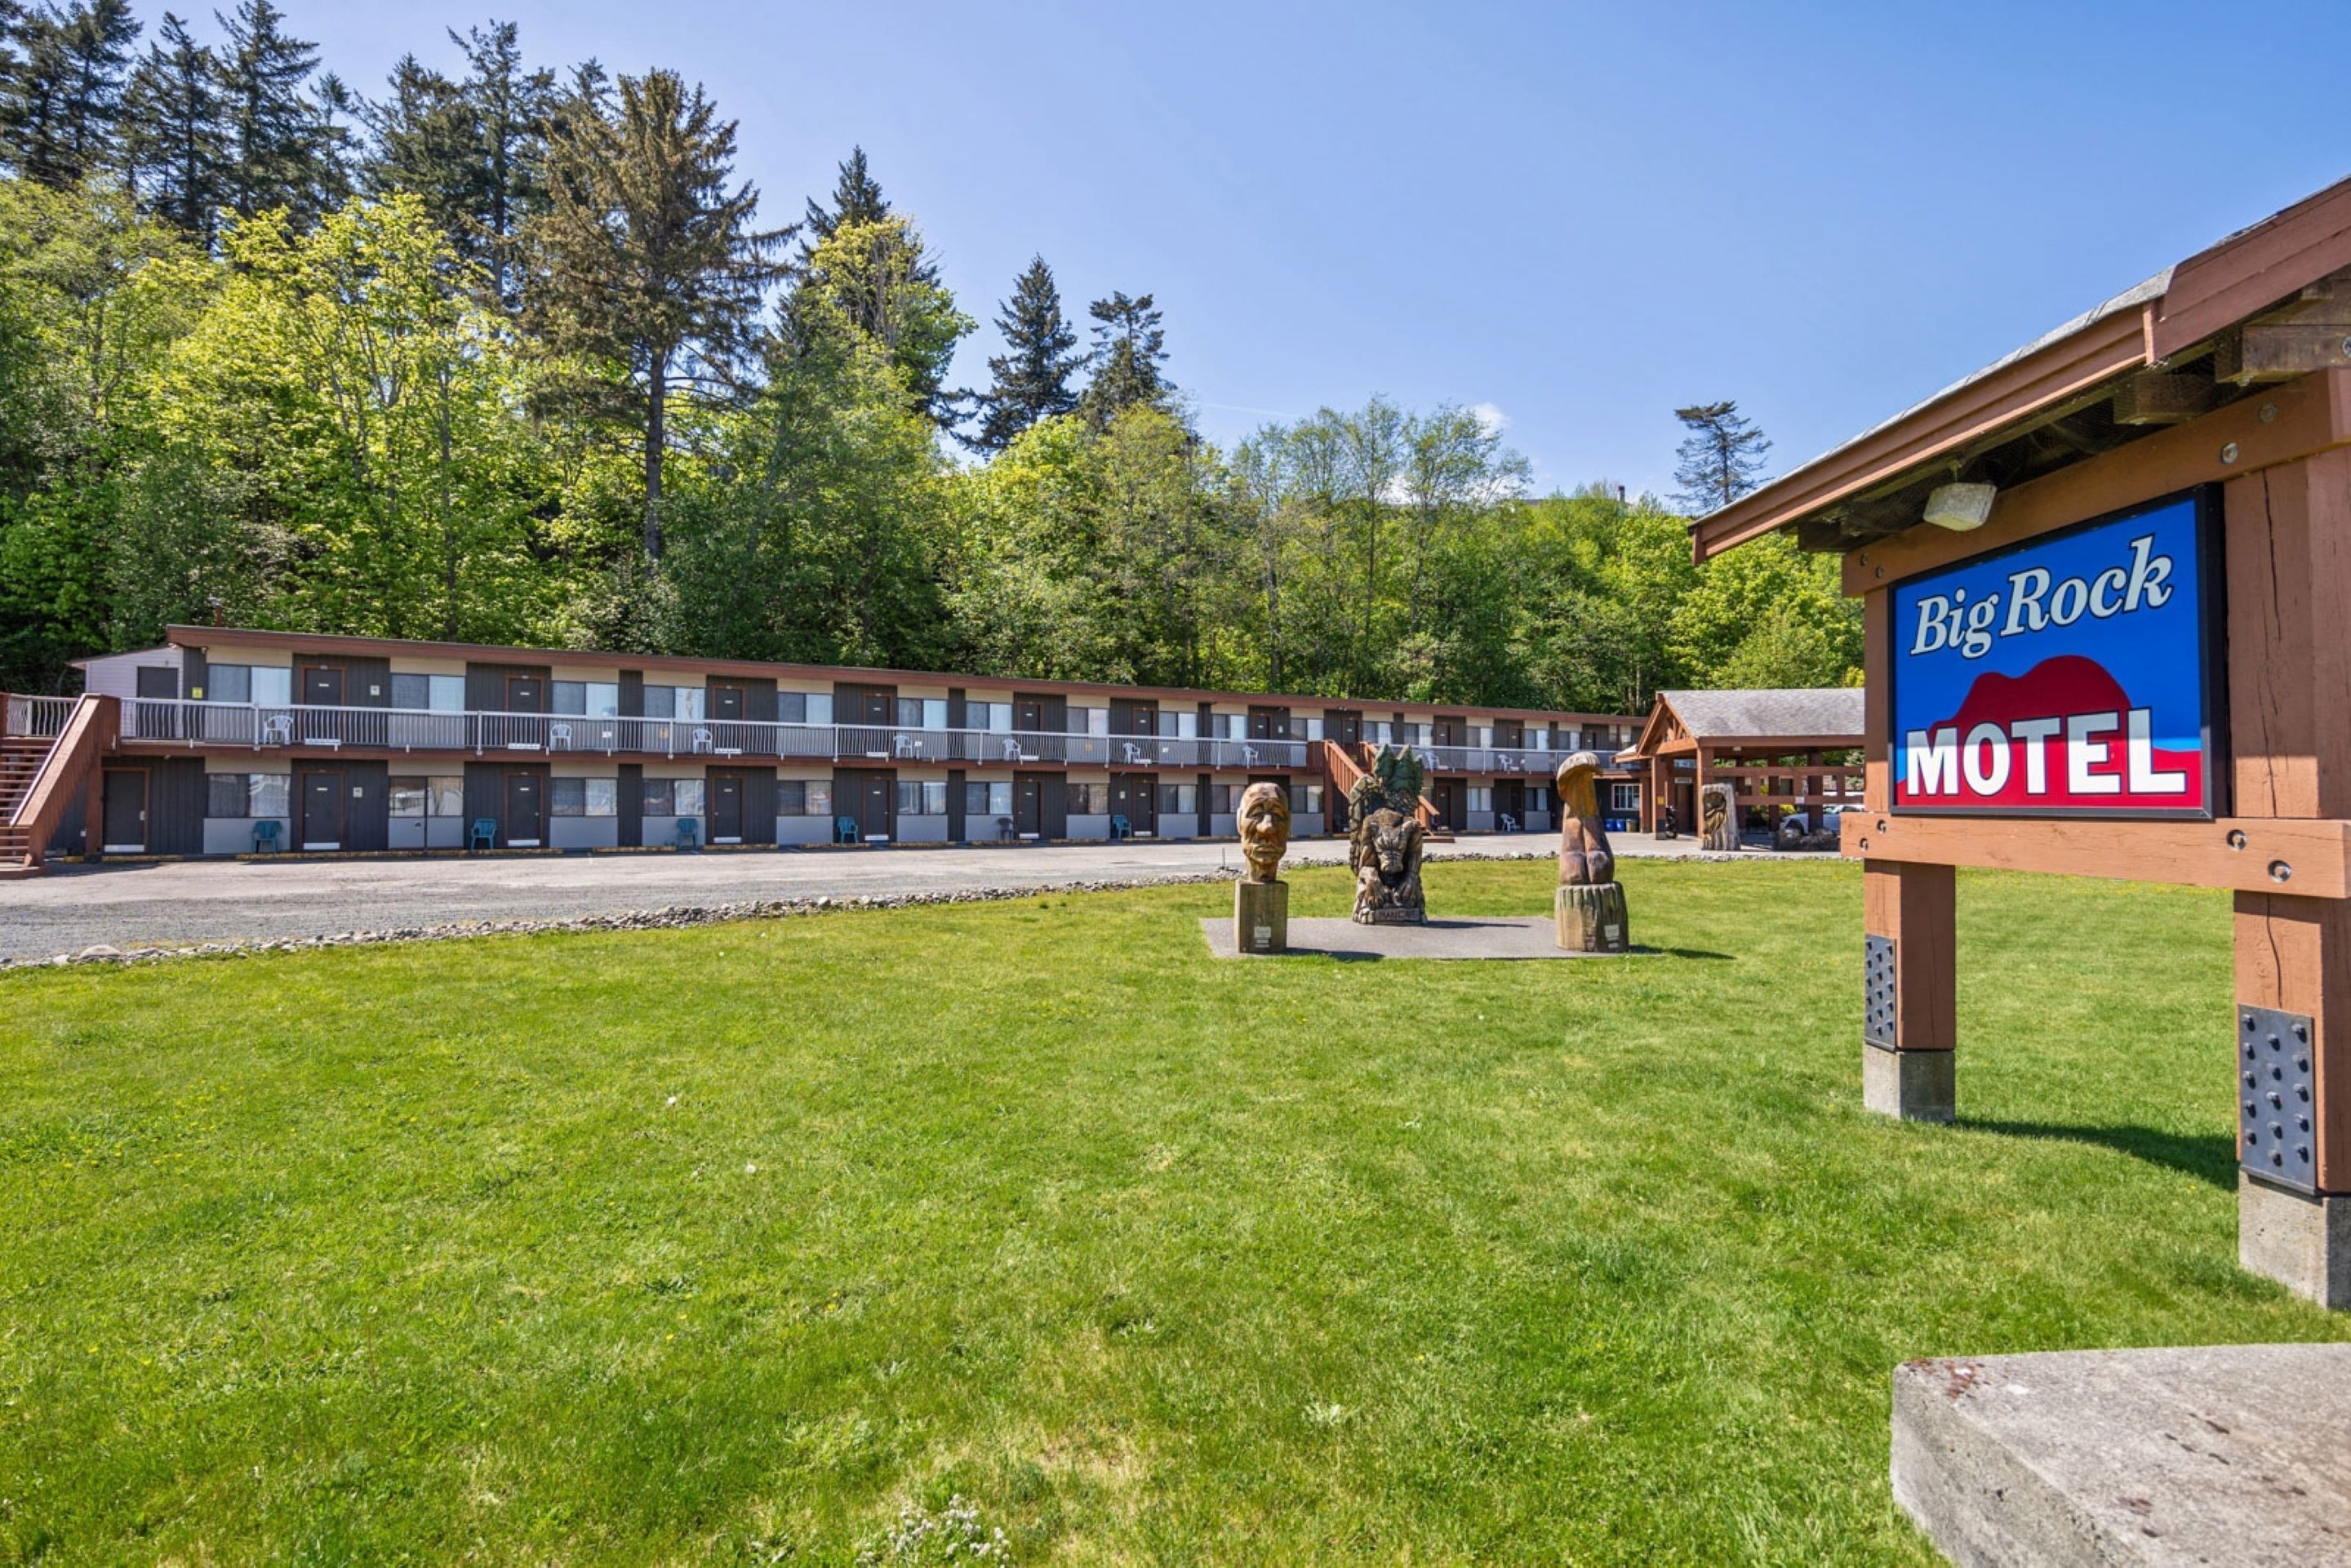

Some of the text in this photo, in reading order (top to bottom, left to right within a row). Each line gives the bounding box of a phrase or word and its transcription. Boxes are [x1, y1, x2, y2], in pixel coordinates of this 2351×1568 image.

[1910, 535, 2173, 659] Big Rock
[1906, 708, 2186, 795] MOTEL
